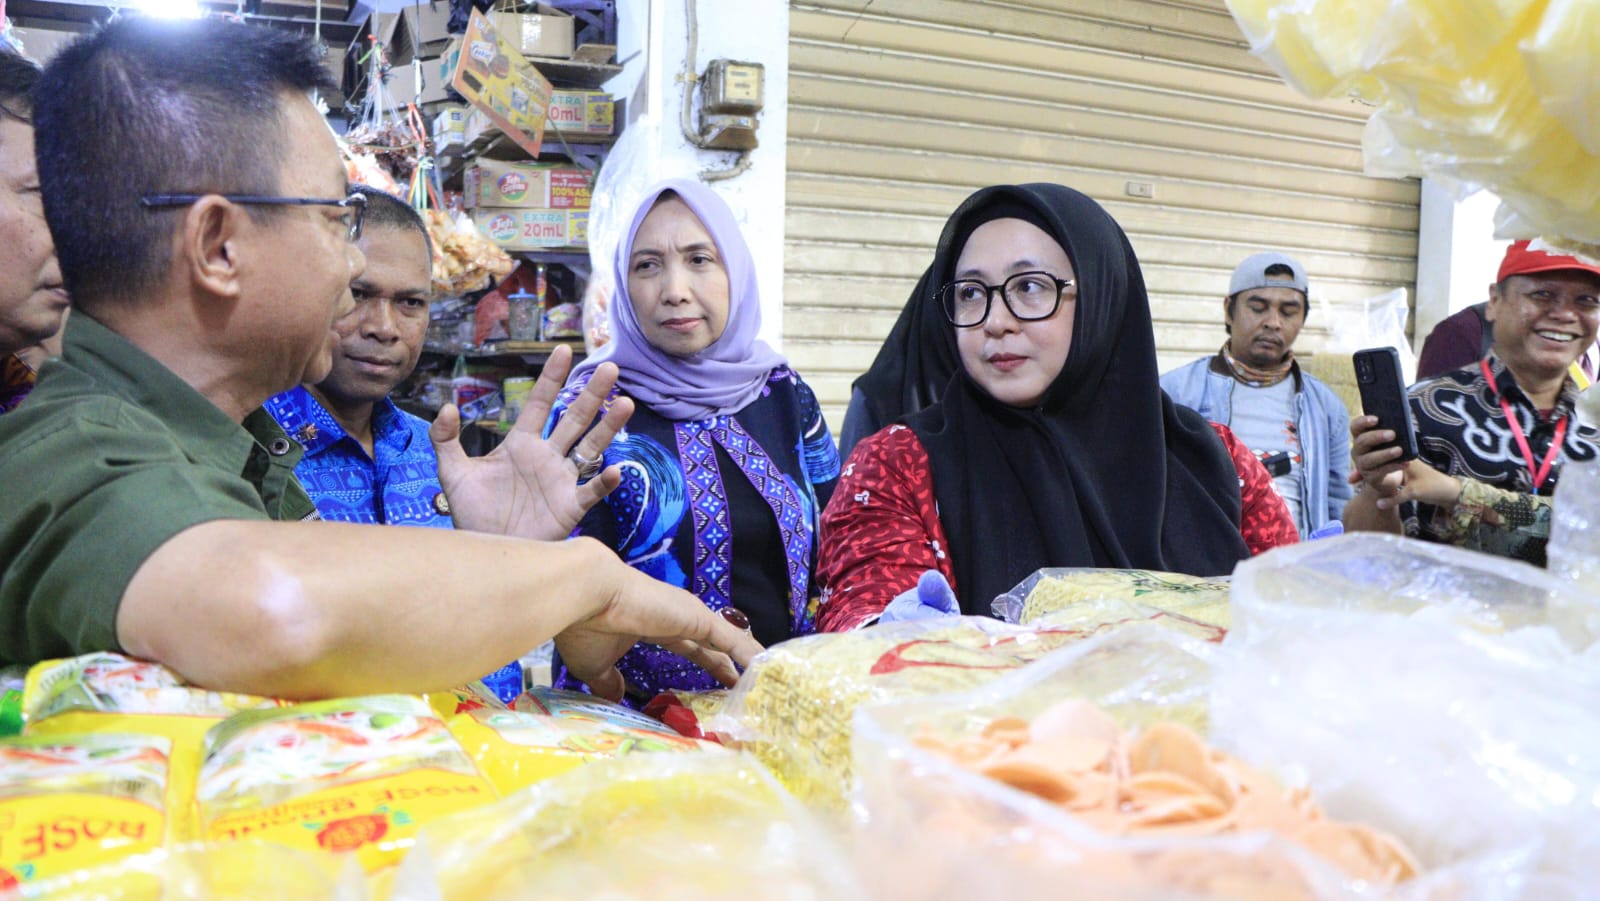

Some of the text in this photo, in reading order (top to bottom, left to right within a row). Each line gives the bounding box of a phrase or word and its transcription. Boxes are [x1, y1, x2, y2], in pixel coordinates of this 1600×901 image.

[550, 96, 581, 104] XTRA
[551, 106, 582, 121] 0mL
[523, 213, 563, 223] EXTRA
[524, 223, 564, 237] 20mL
